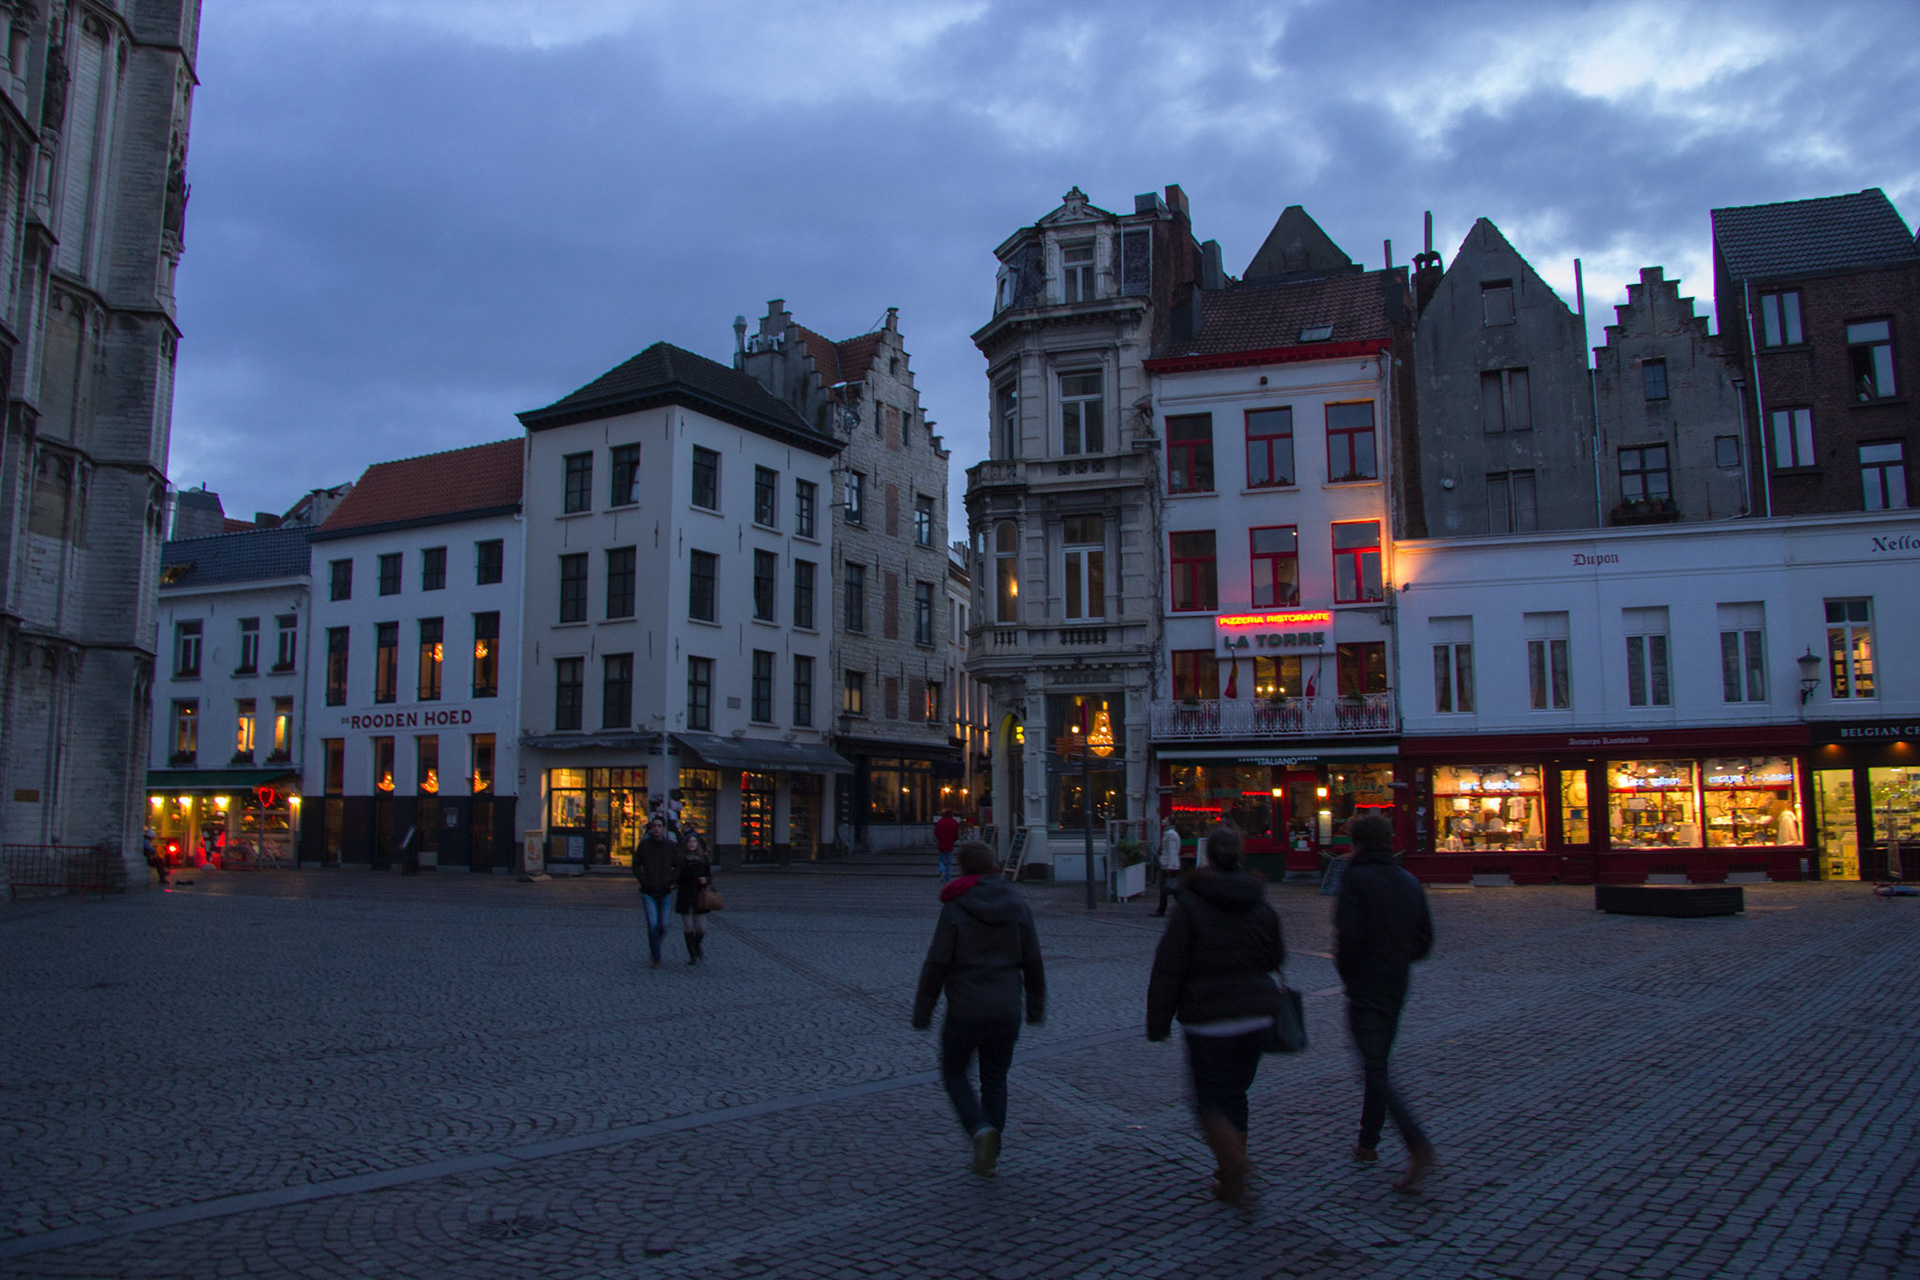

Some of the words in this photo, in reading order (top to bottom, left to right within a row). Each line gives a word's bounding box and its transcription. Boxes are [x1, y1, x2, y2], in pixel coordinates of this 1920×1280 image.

[1572, 554, 1619, 566] Dupon
[1219, 617, 1264, 625] PIZZERIA
[1266, 613, 1330, 623] RISTORANTE
[1224, 635, 1249, 648] LA
[1255, 631, 1325, 648] TORRE
[351, 712, 417, 729] ROODEN
[424, 710, 472, 726] HOED
[1840, 727, 1900, 737] BELGIAN
[1257, 757, 1298, 766] ITALIANO
